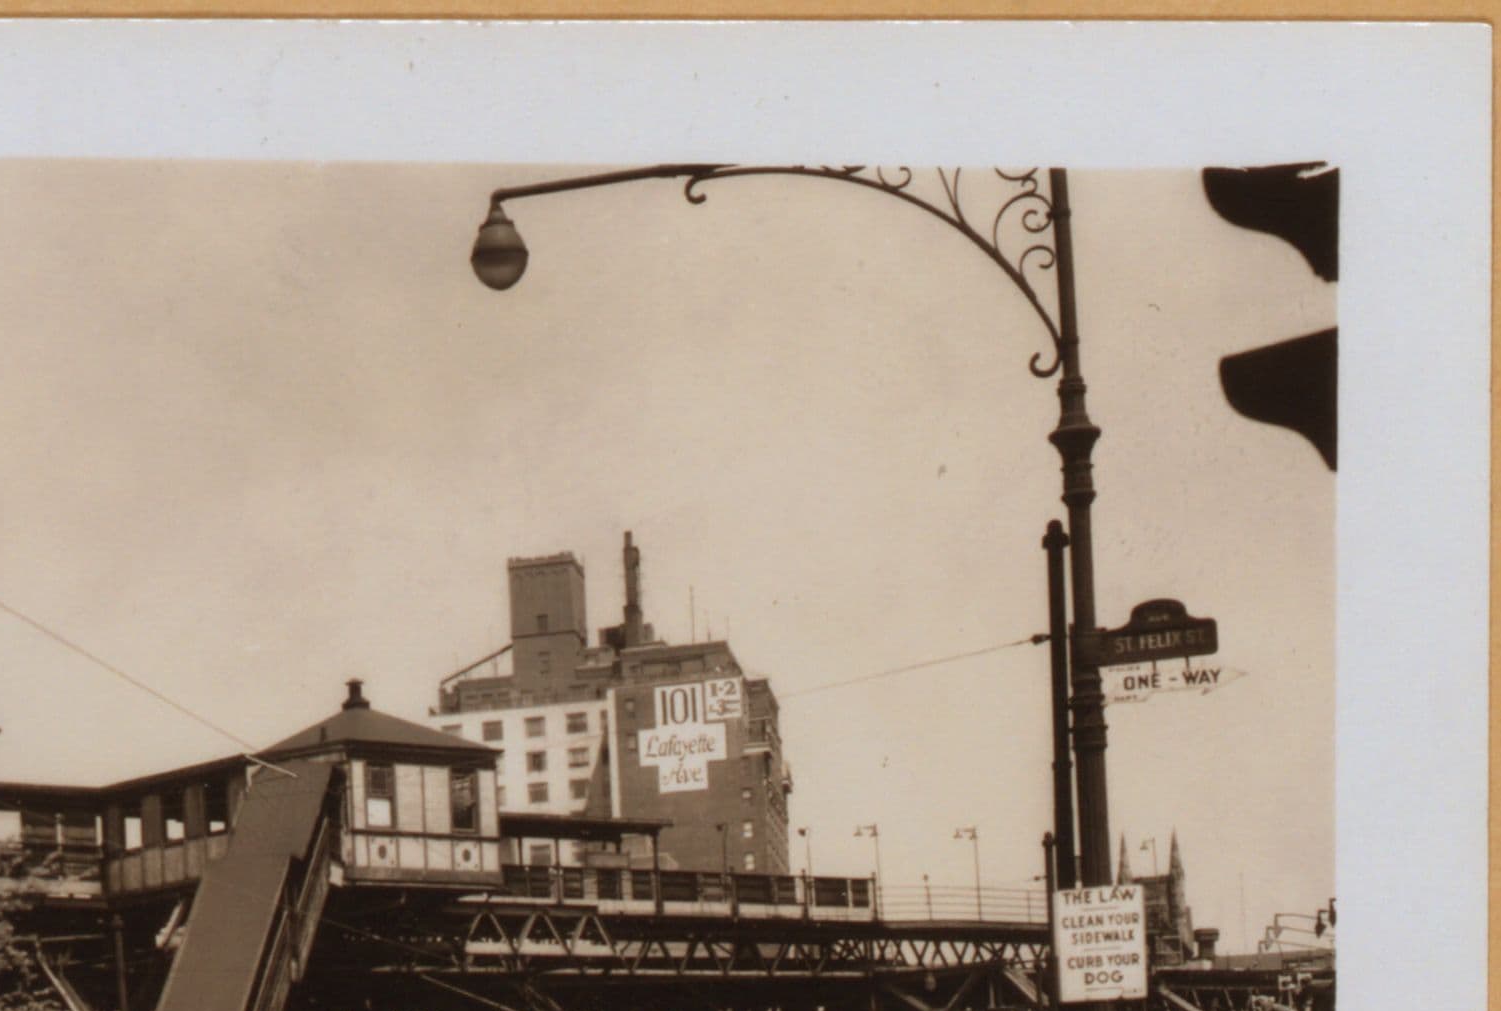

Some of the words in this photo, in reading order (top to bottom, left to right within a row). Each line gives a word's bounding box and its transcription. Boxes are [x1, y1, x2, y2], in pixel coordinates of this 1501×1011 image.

[1138, 631, 1182, 650] FELIX
[661, 686, 697, 726] 101
[645, 734, 715, 761] Lafayette
[1062, 889, 1092, 904] THE
[1099, 886, 1136, 903] LAW
[1061, 915, 1104, 929] CLEAN
[1108, 912, 1140, 925] YOUR
[1071, 930, 1135, 945] SIDEWALK
[1067, 955, 1104, 970] CURB
[1107, 953, 1140, 966] YOUR
[1084, 970, 1124, 985] DOG
